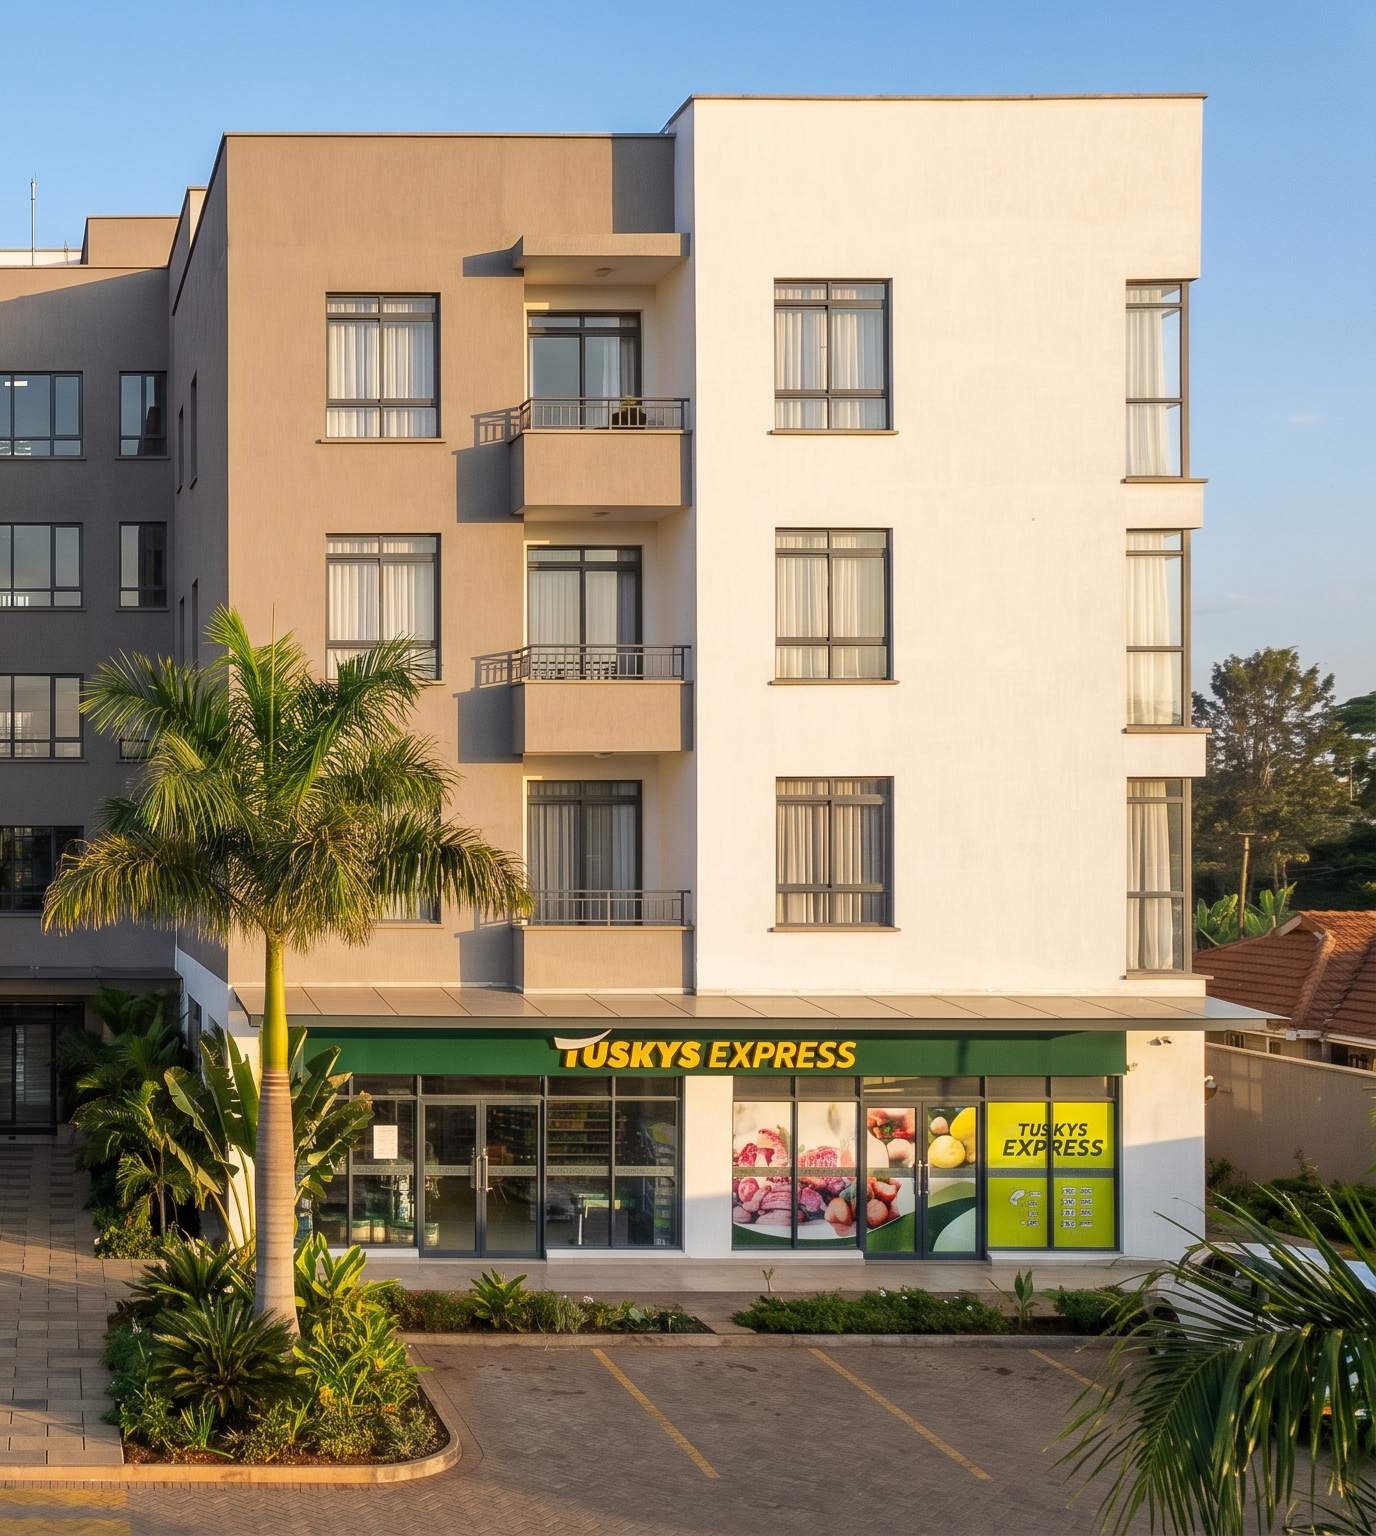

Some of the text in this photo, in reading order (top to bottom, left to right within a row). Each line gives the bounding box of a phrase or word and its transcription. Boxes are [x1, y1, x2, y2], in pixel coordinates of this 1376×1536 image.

[708, 1041, 857, 1069] EXPRESS
[1018, 1123, 1088, 1137] TUSKYS
[1002, 1139, 1104, 1157] EXPRESS
